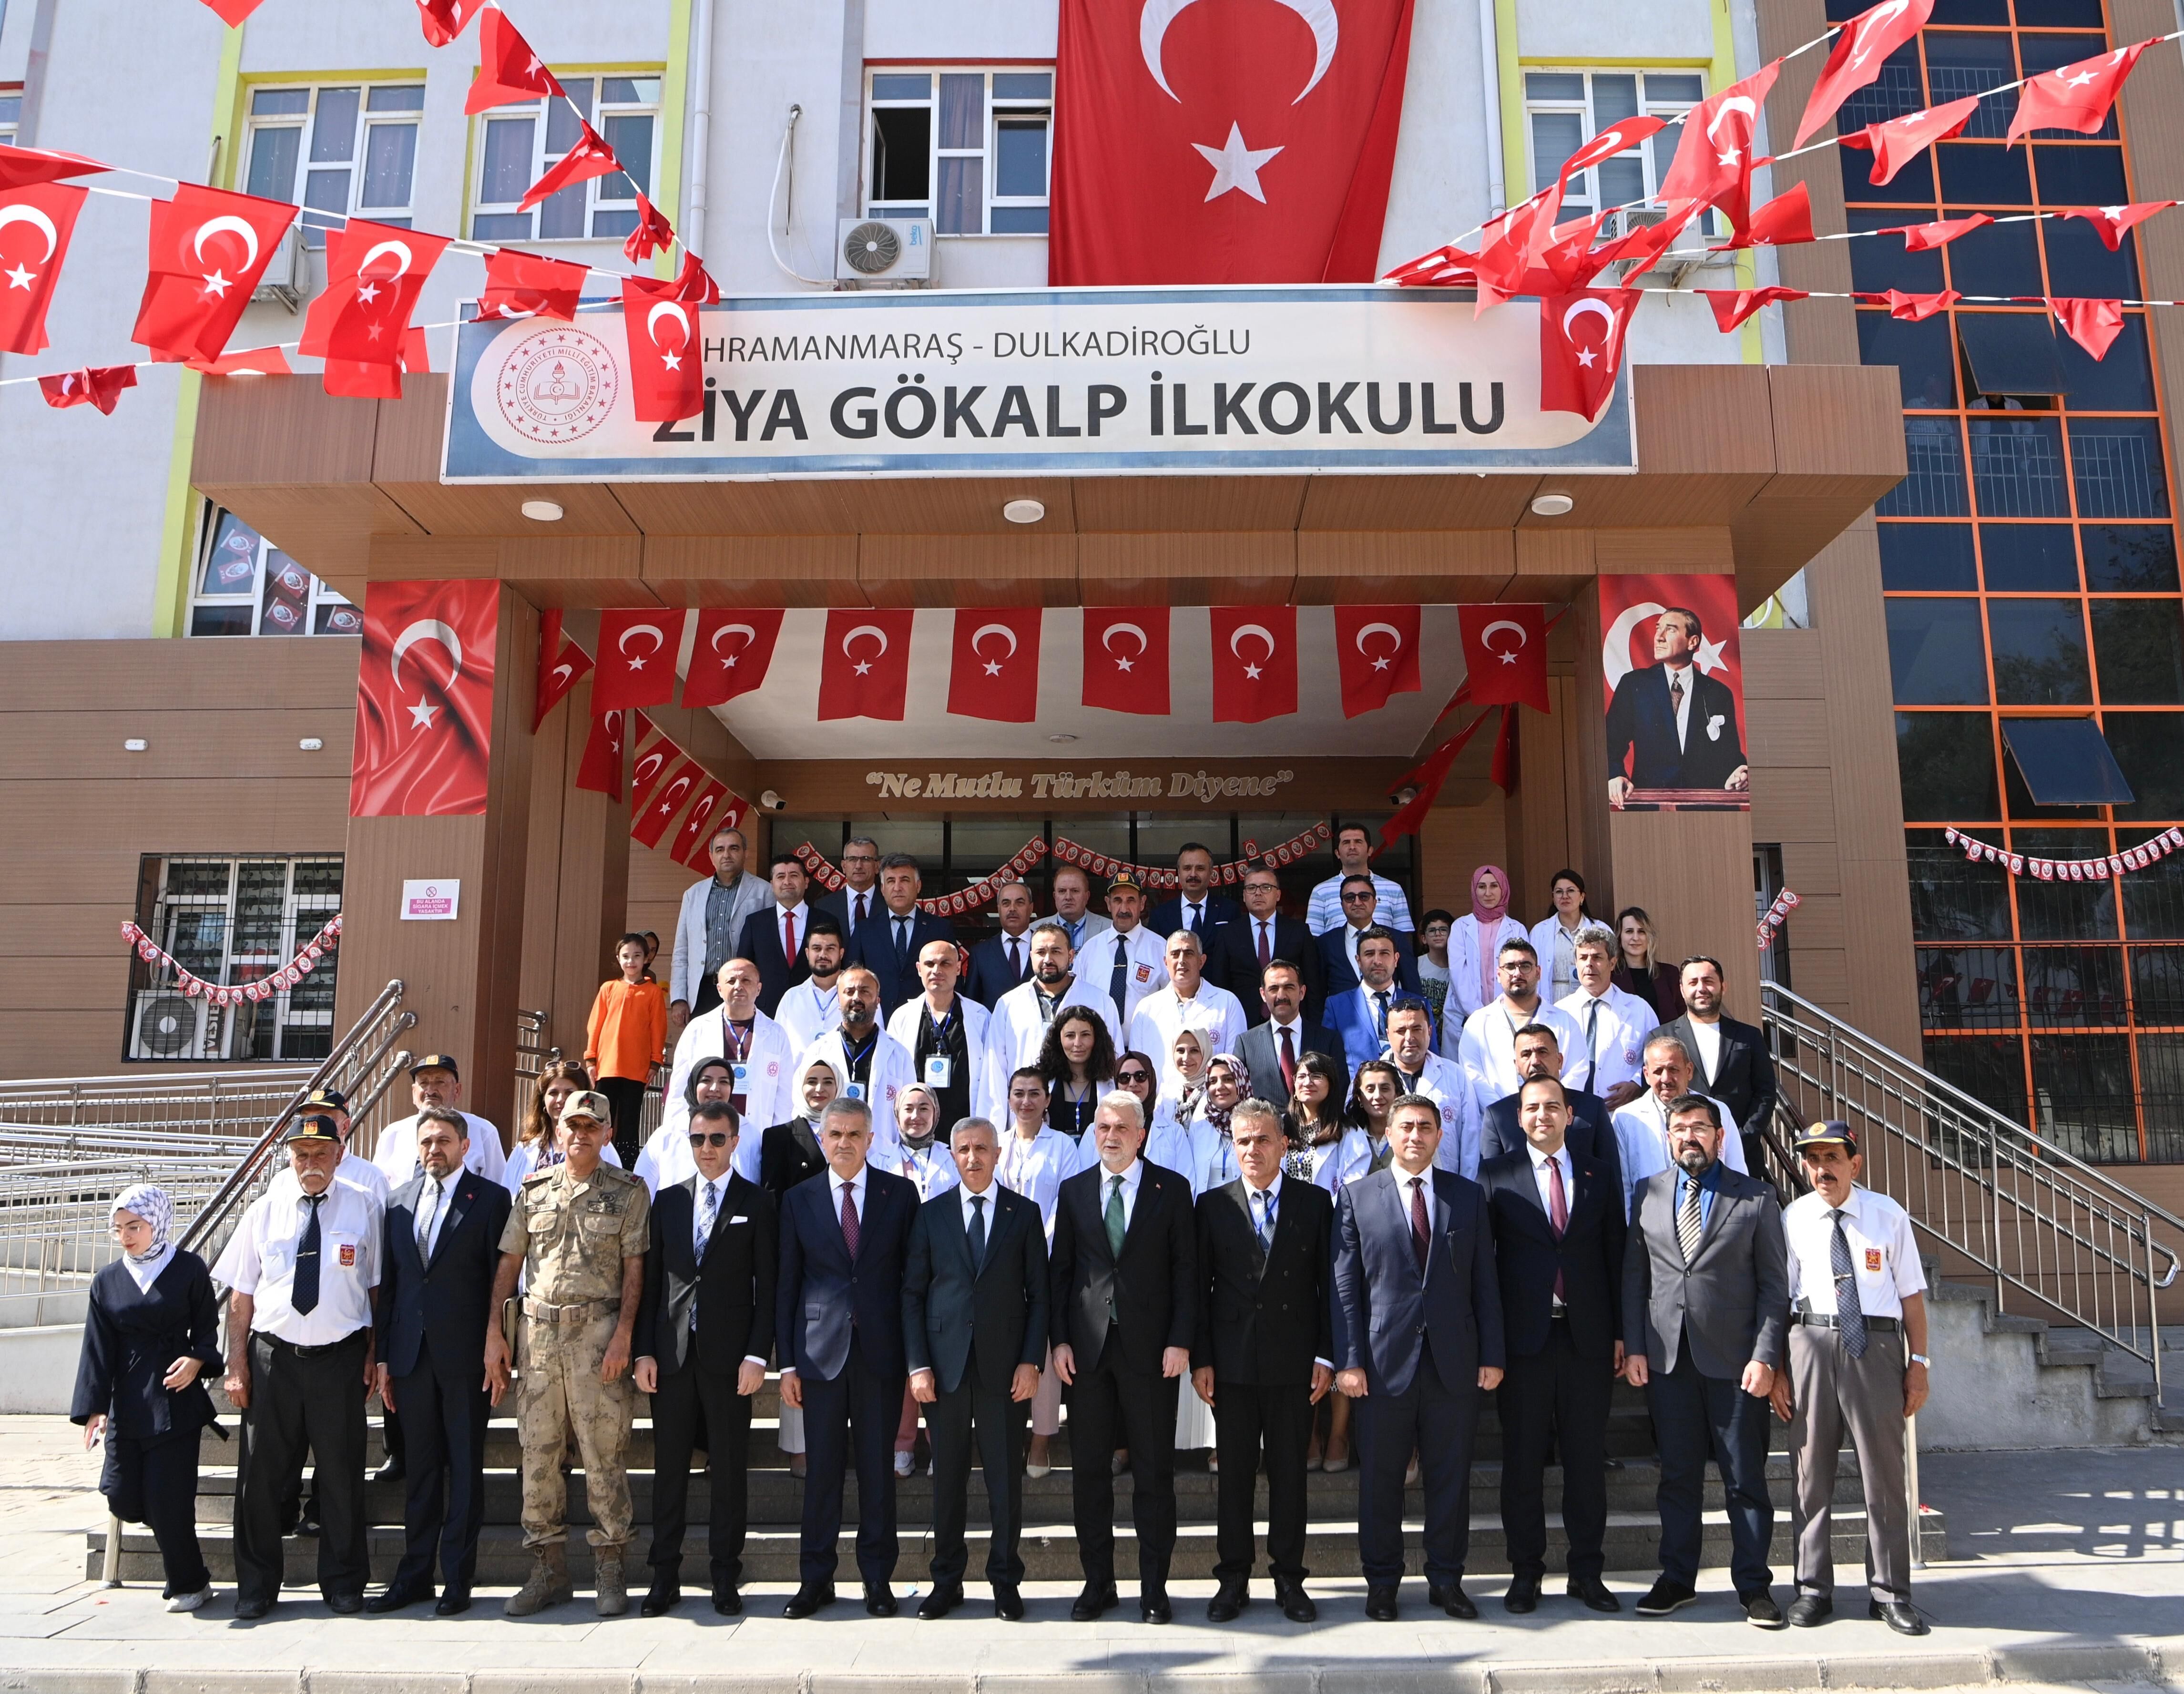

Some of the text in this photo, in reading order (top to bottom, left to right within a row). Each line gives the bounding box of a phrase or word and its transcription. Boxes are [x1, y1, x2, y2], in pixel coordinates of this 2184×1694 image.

[909, 225, 917, 245] beko
[661, 332, 963, 365] HRAMANMARAŞ
[994, 324, 1249, 357] DULKADİROĞLU
[519, 348, 596, 421] TÜRKİYE CUMHURİYETİ MİLLİ EĞİTİM BAKANLIĞI
[653, 370, 1505, 442] ZİYA GÖKALP İLKOKULU
[922, 771, 1022, 798] Mutlu
[1031, 771, 1162, 798] Türküm
[1167, 770, 1294, 803] Diyene”
